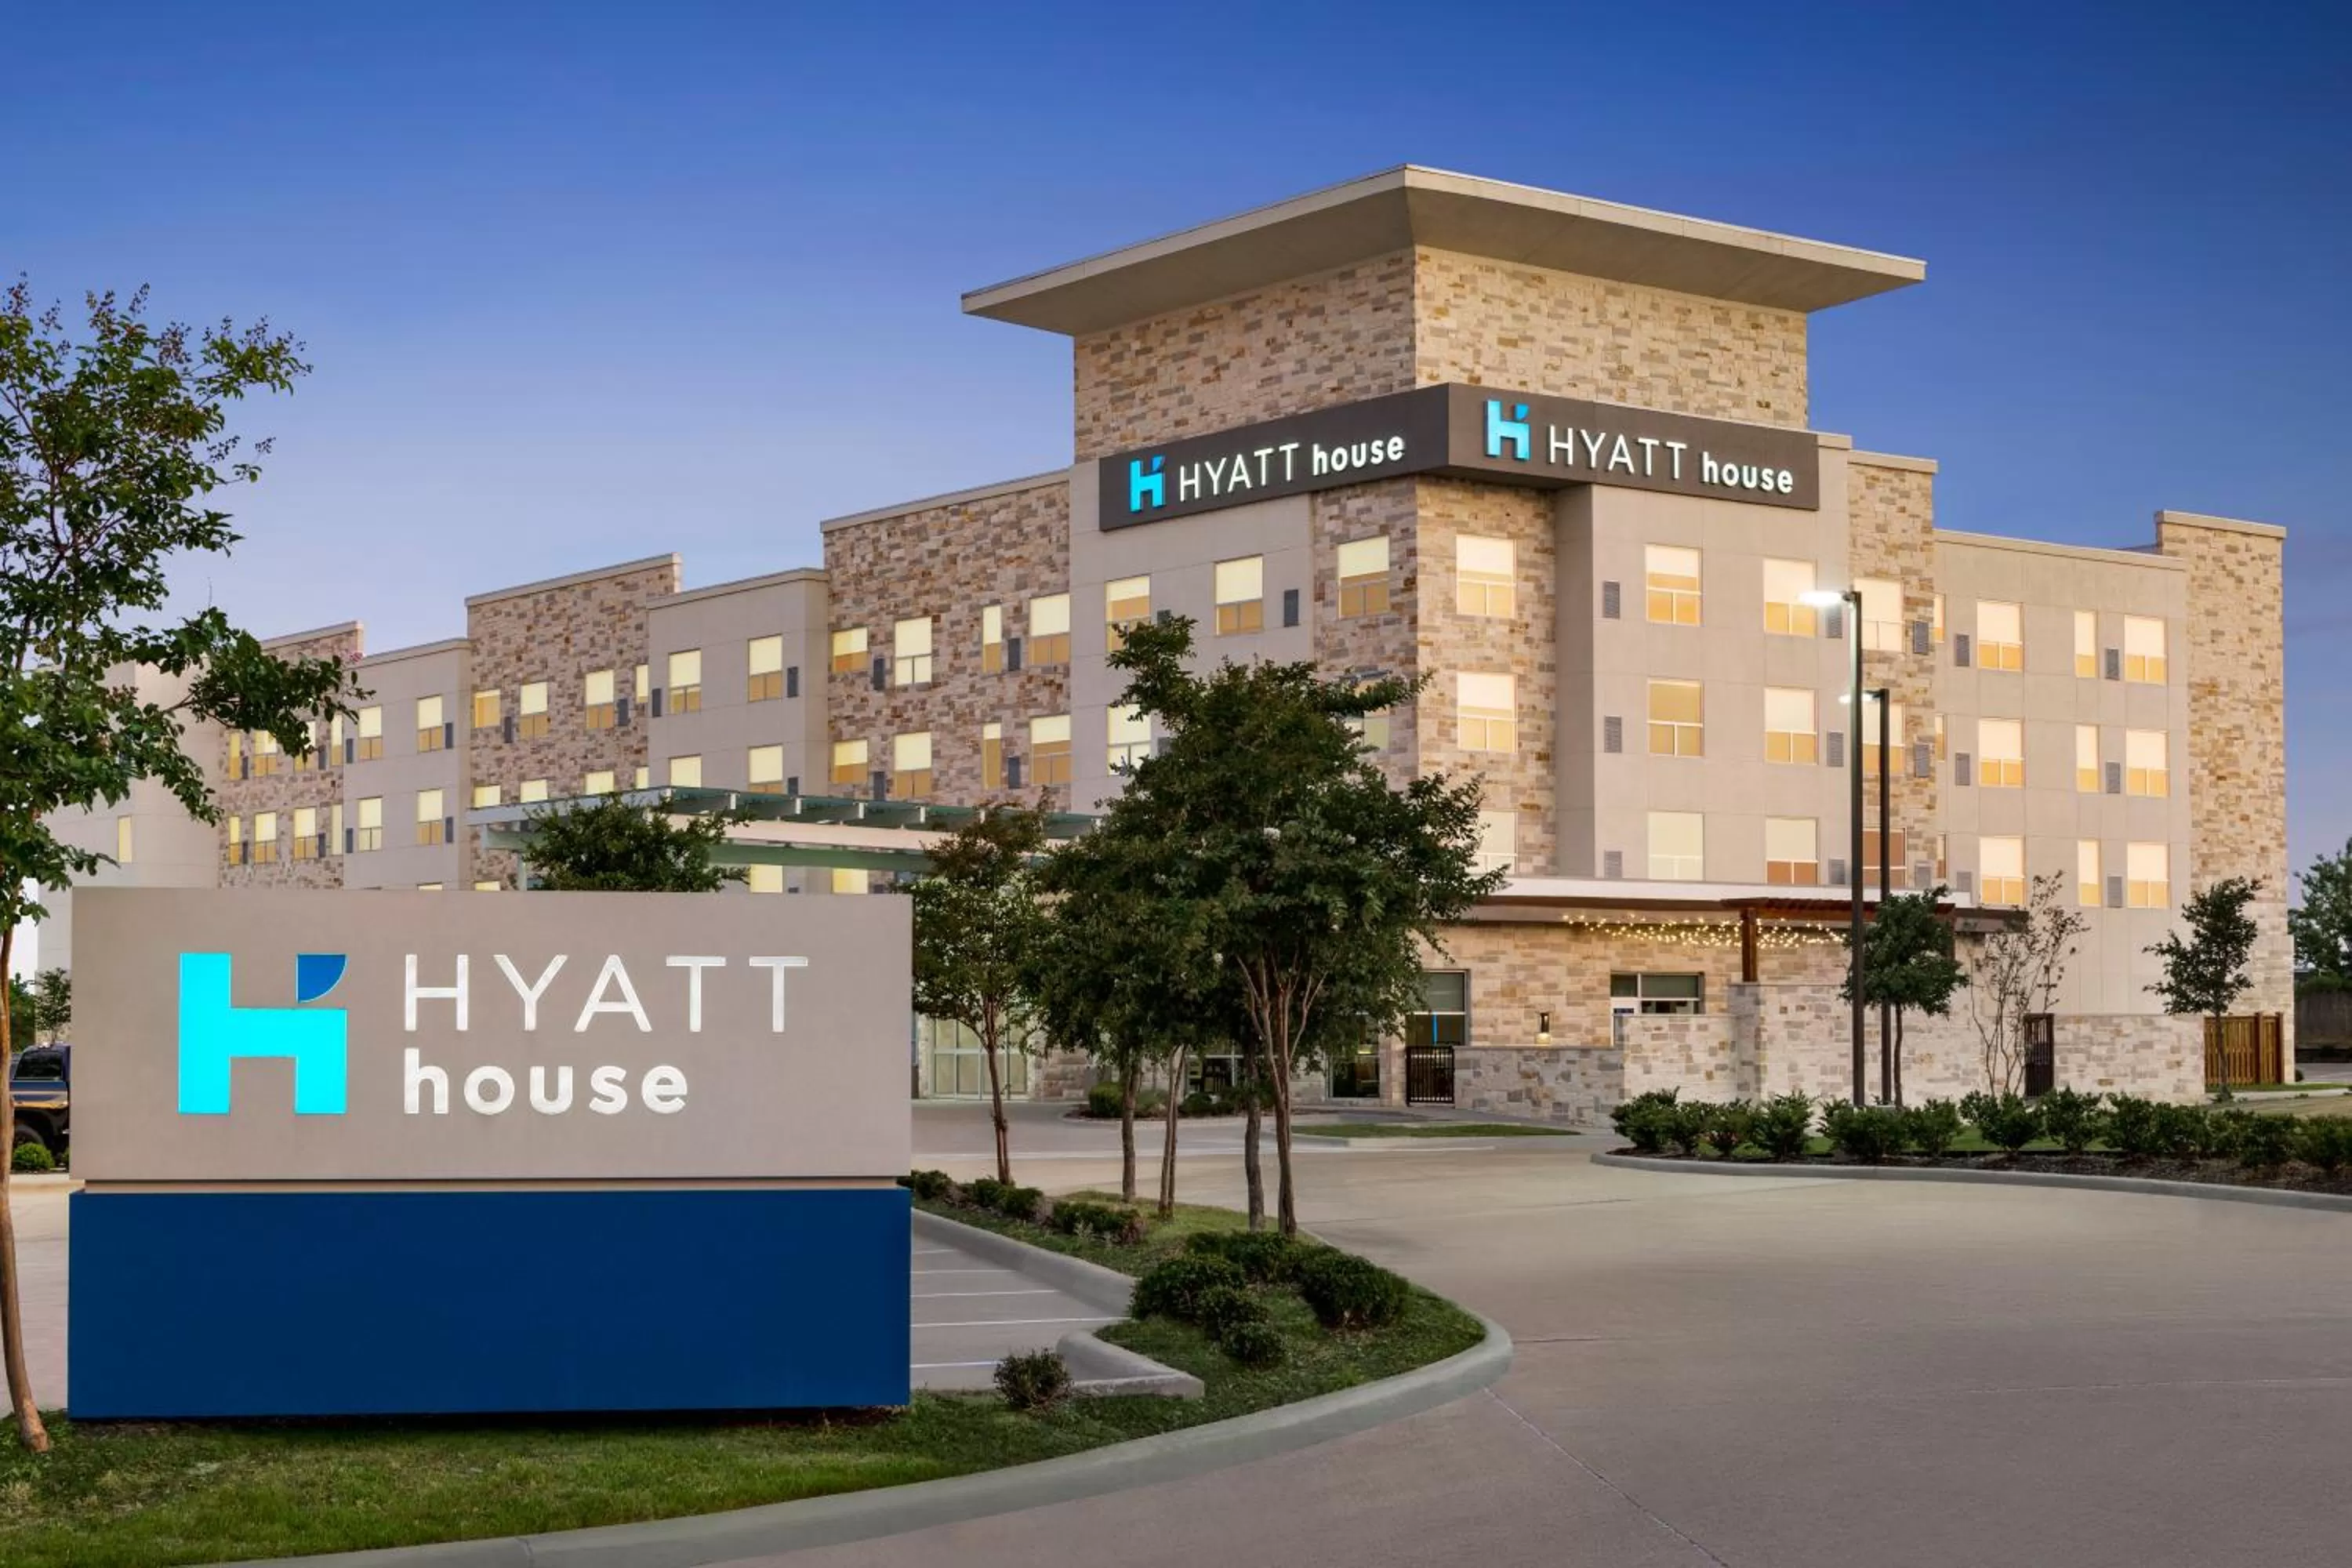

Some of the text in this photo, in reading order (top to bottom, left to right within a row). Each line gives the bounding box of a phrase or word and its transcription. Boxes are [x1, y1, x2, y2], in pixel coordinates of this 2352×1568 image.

[1179, 443, 1299, 502] HYATT
[1312, 435, 1405, 476] house
[1548, 424, 1687, 479] HYATT
[1702, 452, 1794, 493] house
[404, 954, 808, 1033] HYATT
[404, 1047, 688, 1115] house
